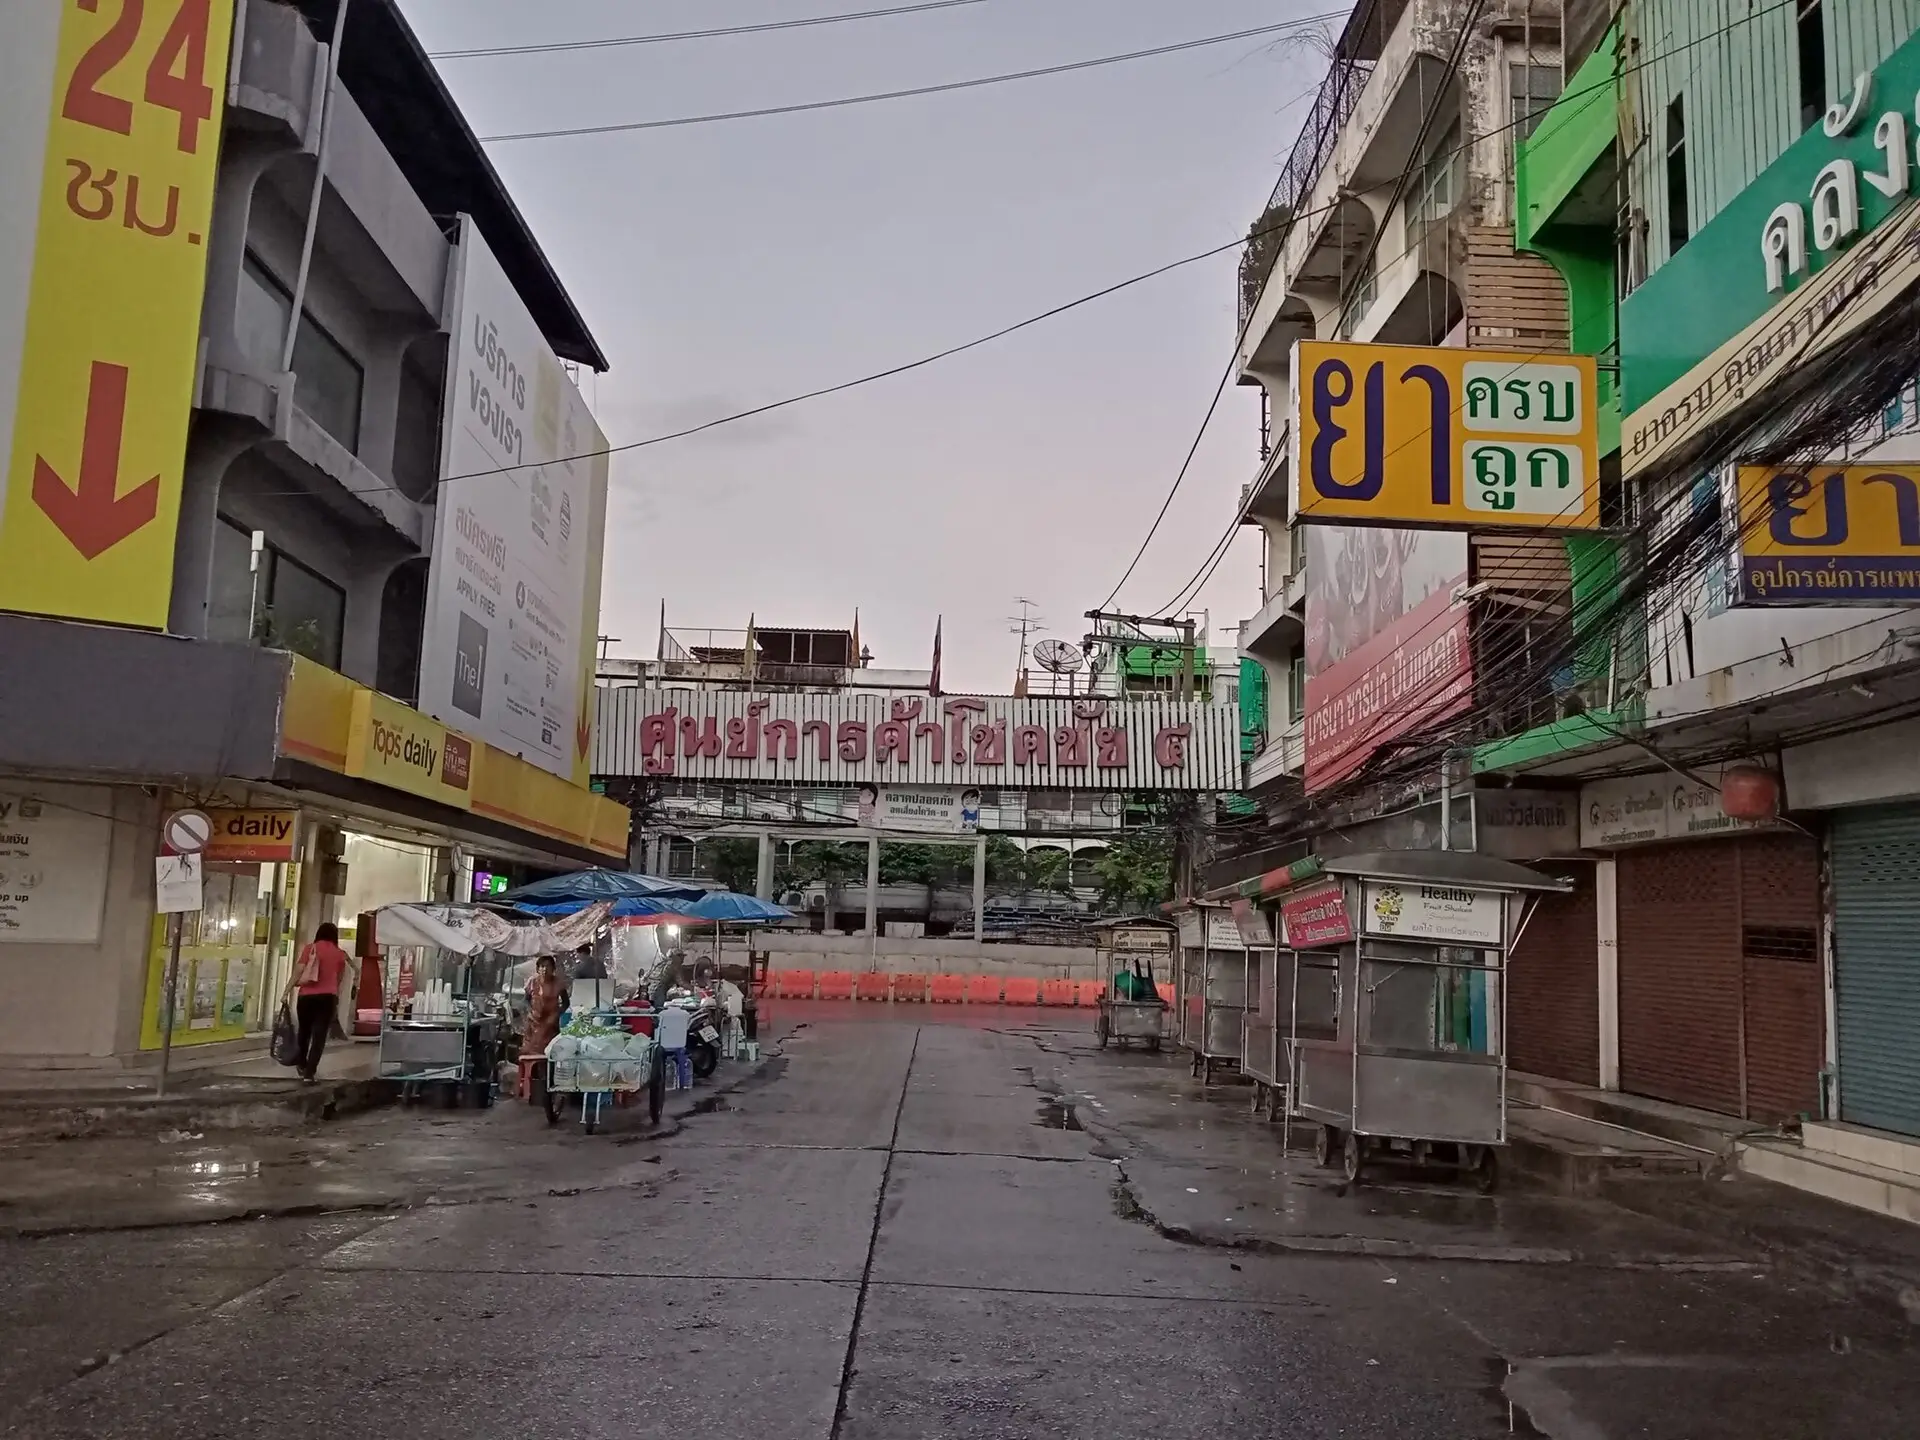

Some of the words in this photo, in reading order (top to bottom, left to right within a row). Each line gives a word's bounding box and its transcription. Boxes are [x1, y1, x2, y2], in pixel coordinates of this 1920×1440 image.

[62, 0, 213, 154] 24
[64, 159, 201, 245] ชม.
[1761, 70, 1920, 293] คลัง
[475, 314, 526, 411] บริการ
[469, 369, 523, 465] ของเรา
[1310, 358, 1451, 505] ยา
[1466, 376, 1574, 422] ครบ
[1471, 446, 1570, 511] ถูก
[1768, 472, 1920, 546] ยา
[455, 507, 506, 571] สมัครฟรี!
[456, 576, 477, 604] APPLY
[480, 594, 496, 618] FREE
[372, 719, 402, 765] Tops
[403, 733, 437, 777] daily
[640, 697, 1128, 775] ศูนย์การค้าโชคชัย
[227, 815, 292, 840] daily
[14, 895, 29, 903] up
[1420, 886, 1477, 905] Healthy
